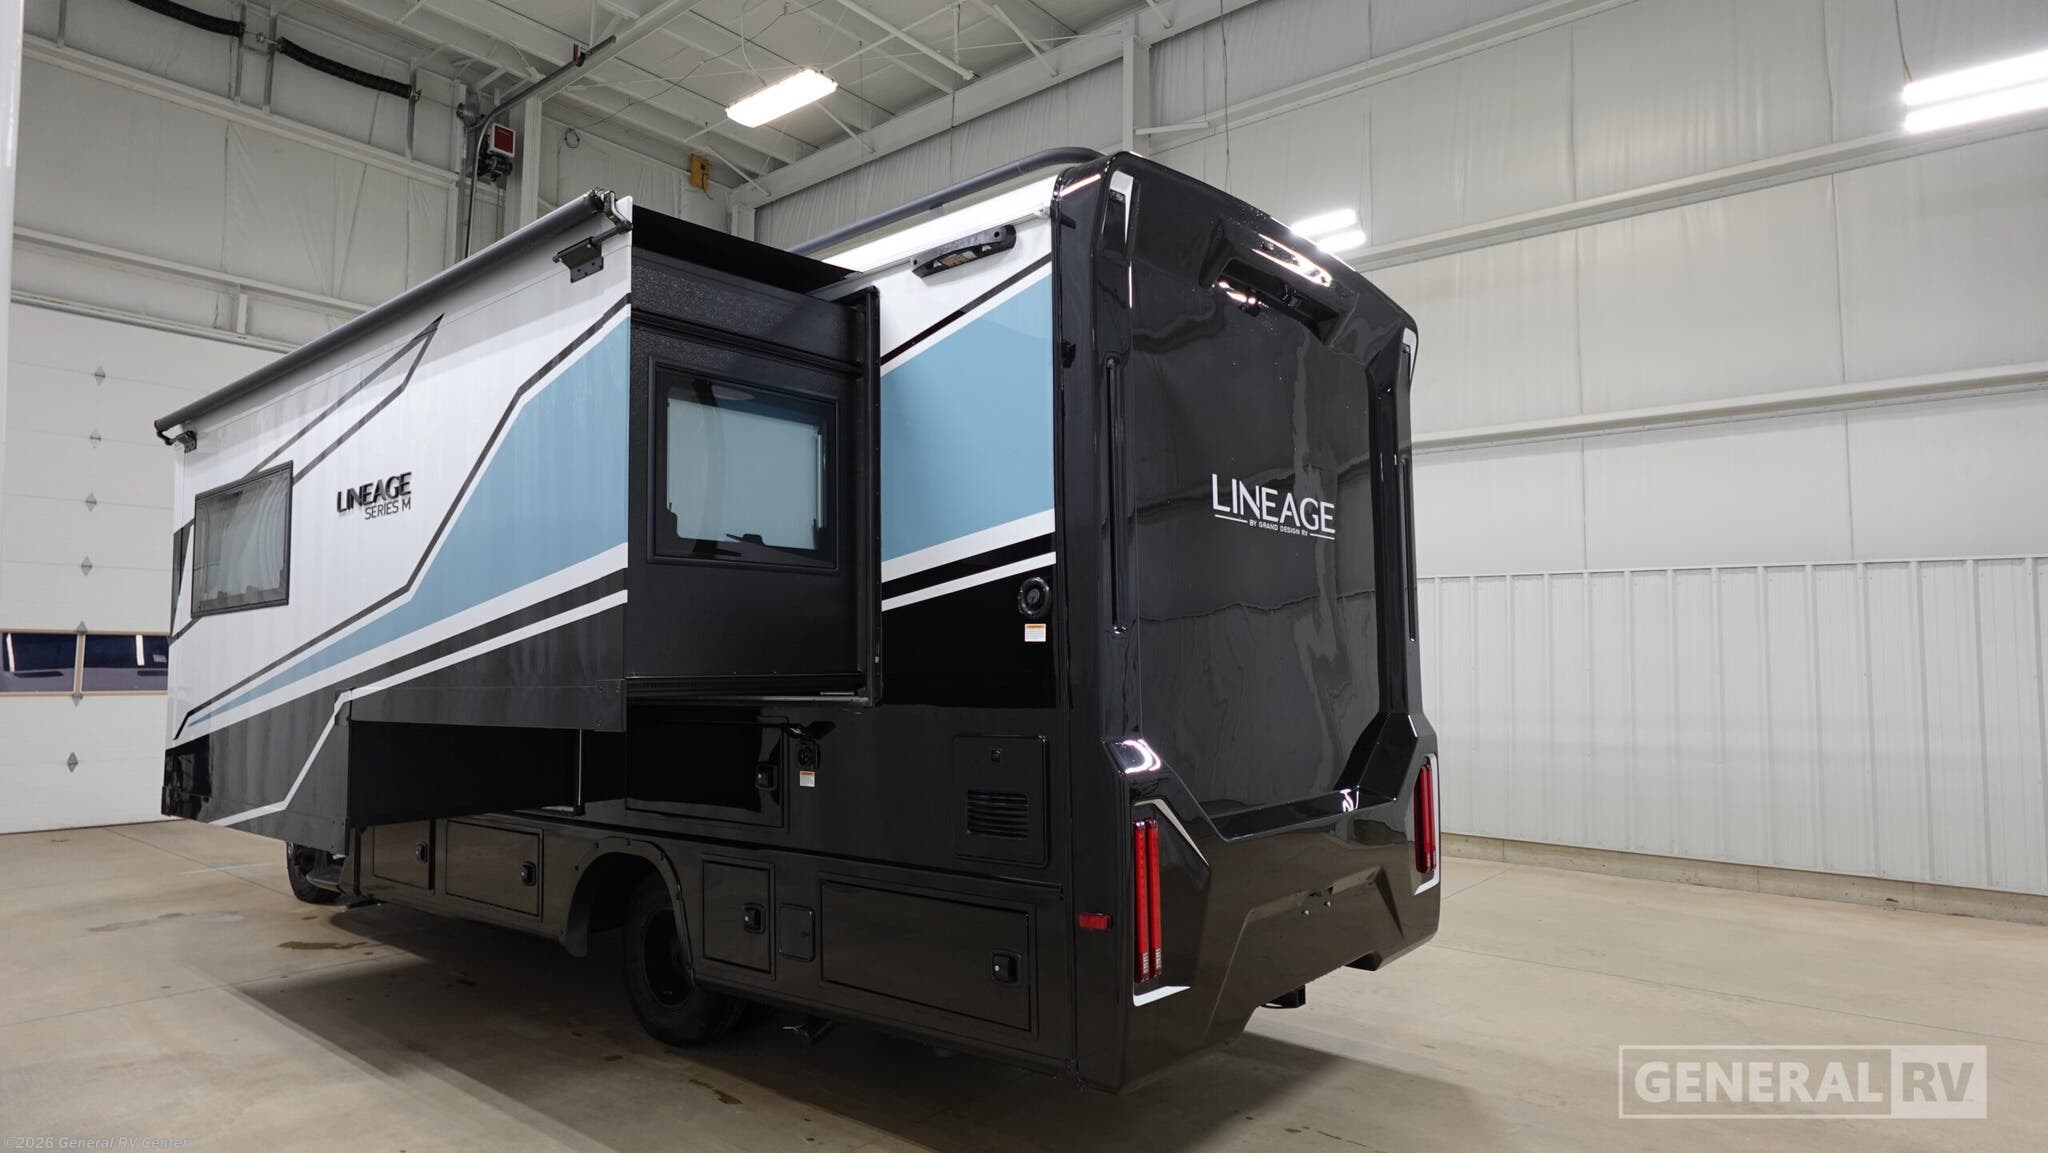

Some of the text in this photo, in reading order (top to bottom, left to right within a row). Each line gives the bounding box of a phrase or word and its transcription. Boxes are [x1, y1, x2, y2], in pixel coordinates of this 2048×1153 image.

[337, 471, 412, 513] LINEAGE
[364, 496, 412, 520] SERIES M
[1212, 473, 1336, 534] LINEAGE
[1249, 519, 1258, 527] BY
[1258, 521, 1279, 531] GRAND
[1280, 525, 1301, 536] DESIGN
